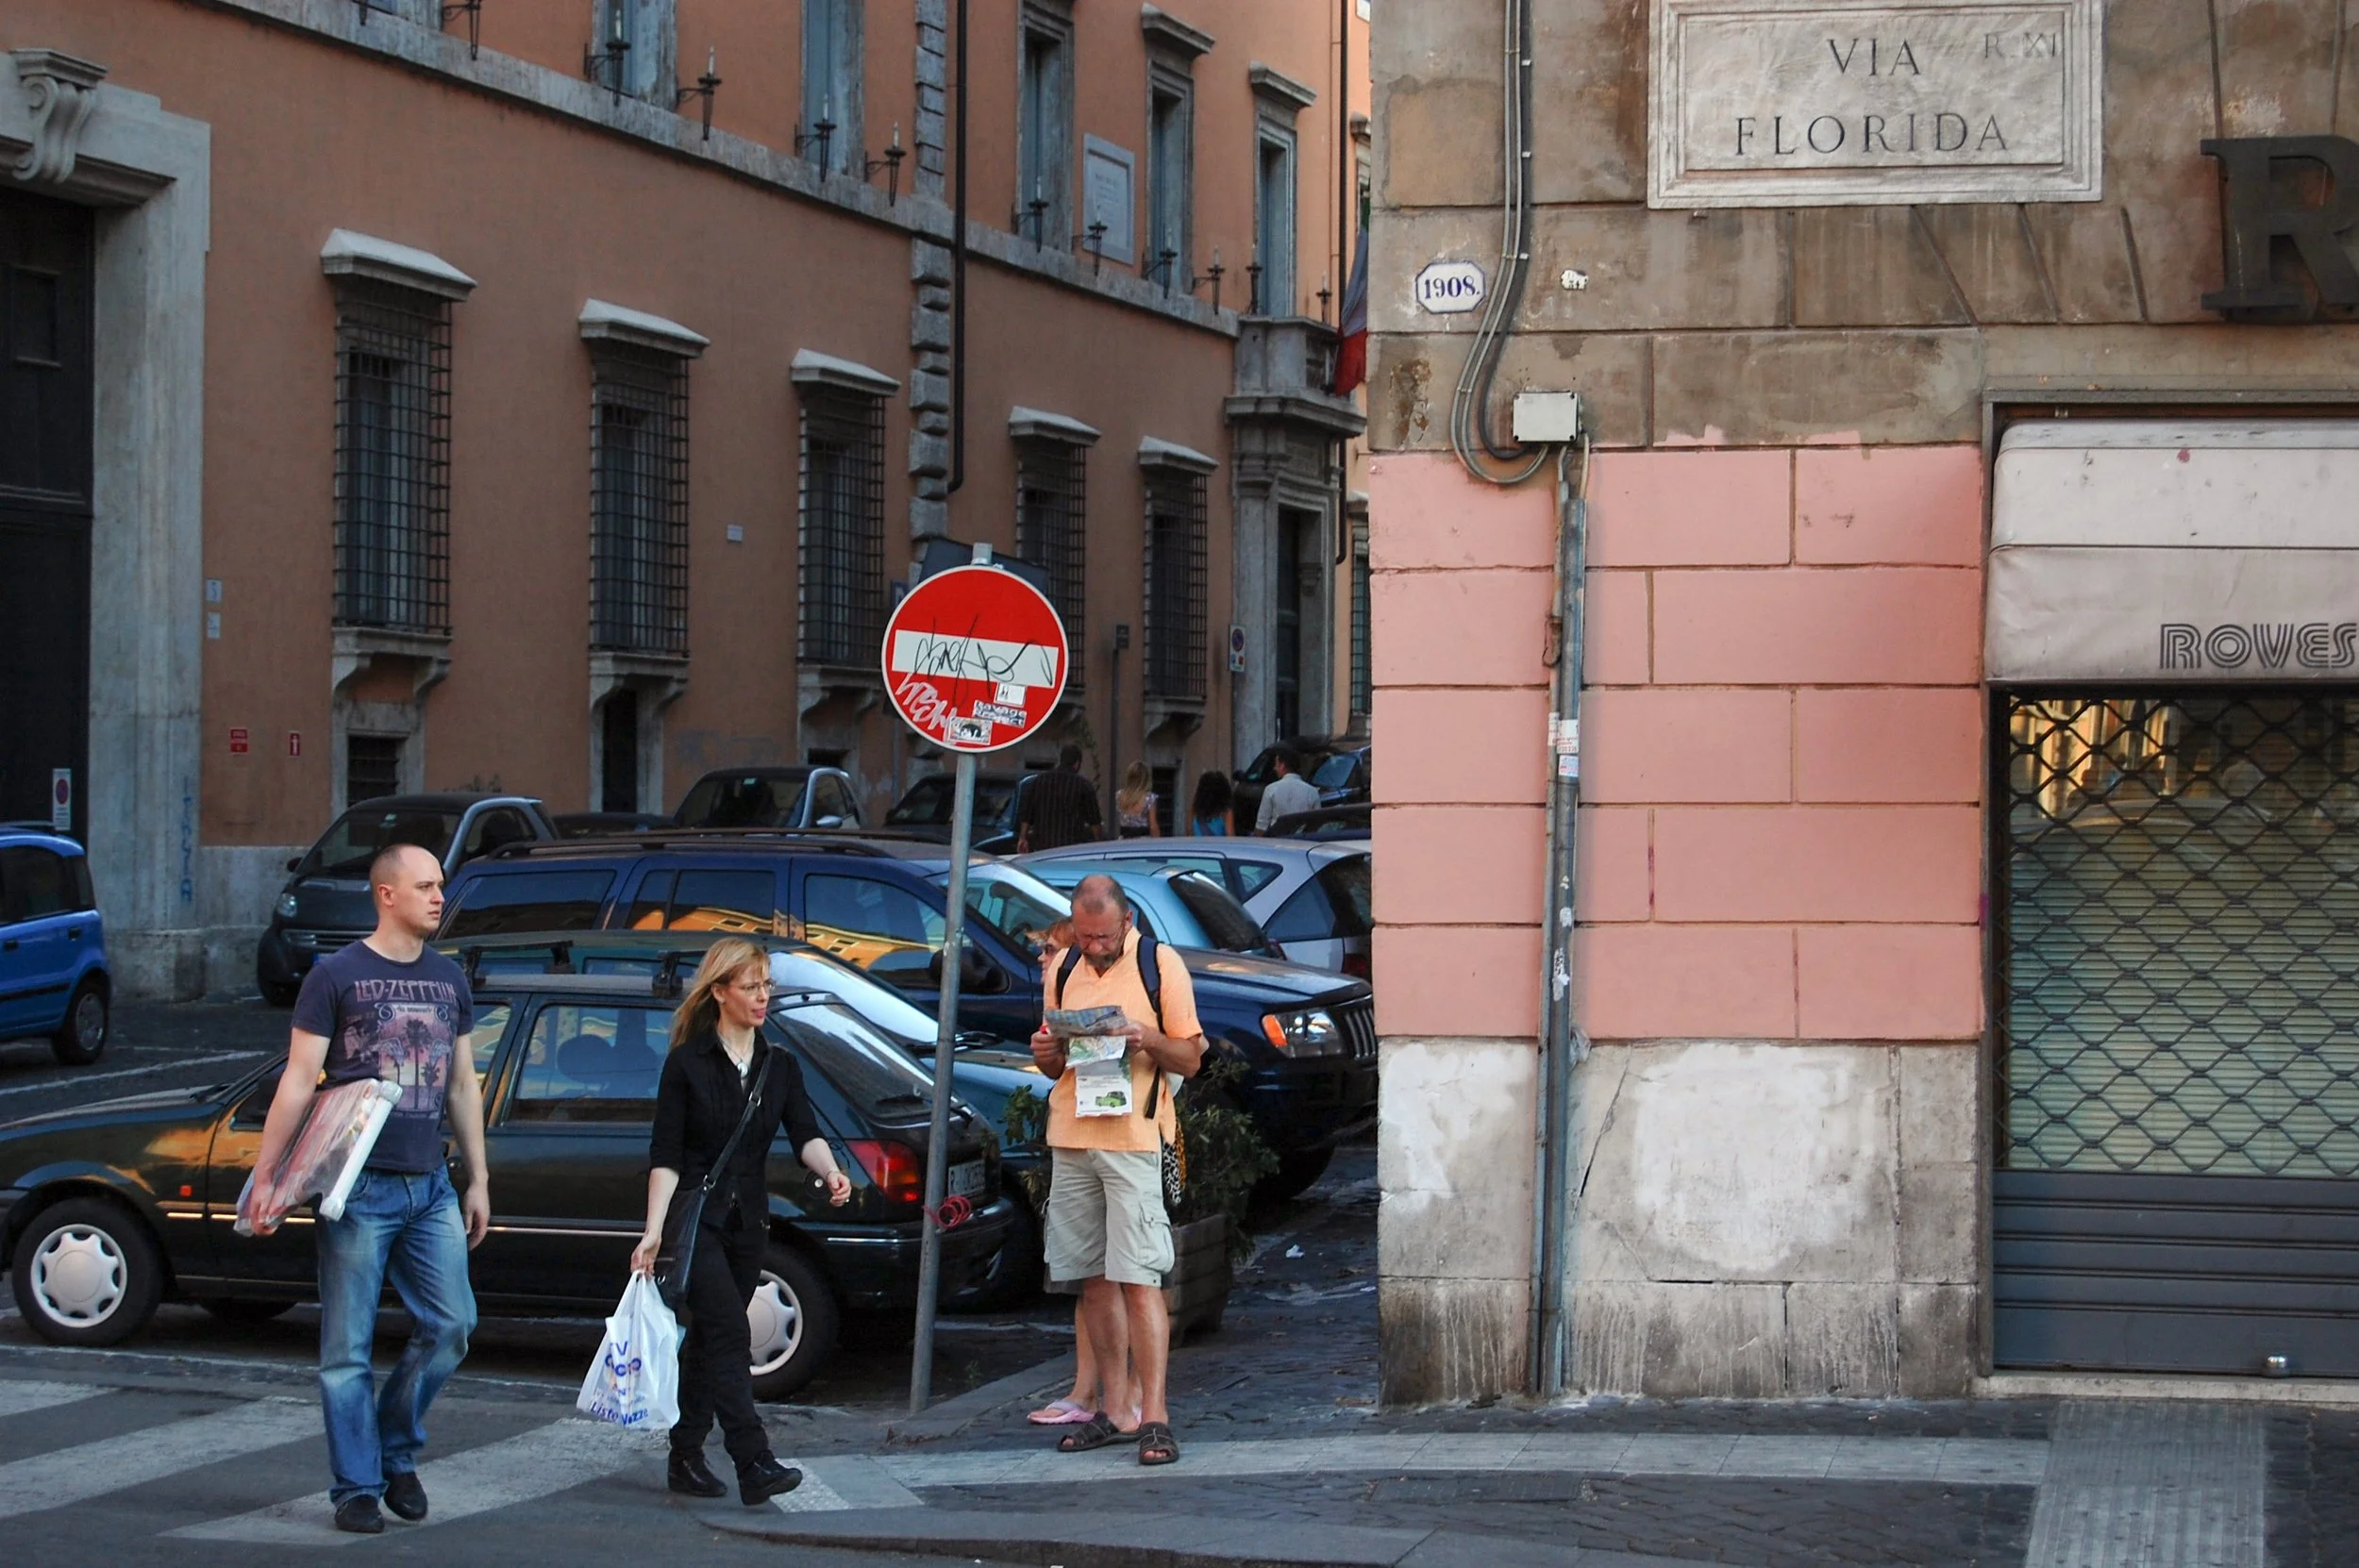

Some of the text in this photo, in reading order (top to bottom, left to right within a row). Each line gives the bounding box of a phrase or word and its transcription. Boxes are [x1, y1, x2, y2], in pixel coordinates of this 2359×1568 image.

[1826, 38, 1921, 76] VIA
[1734, 112, 2008, 156] FLORIDA
[2200, 134, 2359, 310] R
[2159, 623, 2357, 670] ROVES
